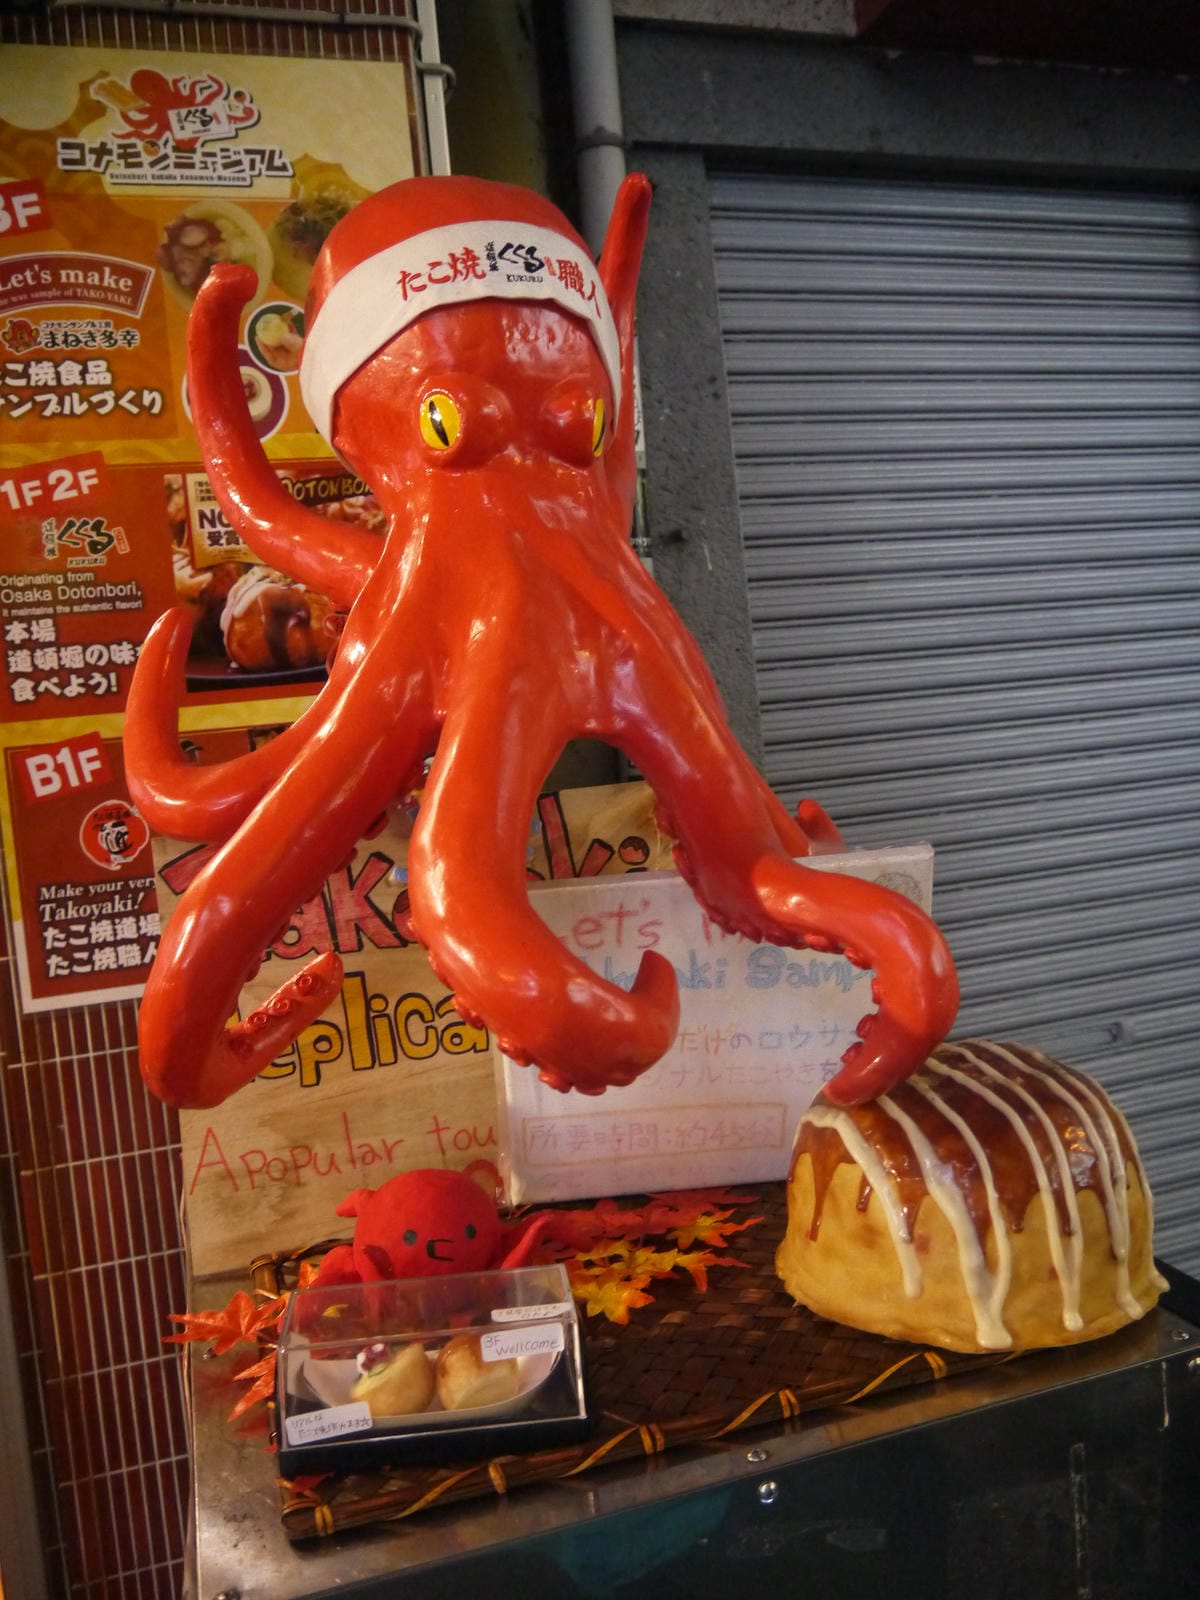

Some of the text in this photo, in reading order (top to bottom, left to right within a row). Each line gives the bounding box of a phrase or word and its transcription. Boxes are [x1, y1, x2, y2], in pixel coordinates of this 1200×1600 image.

[60, 267, 133, 292] make
[397, 246, 487, 300] たこ焼
[43, 330, 138, 348] まねき多幸
[0, 360, 112, 387] こ焼食品
[0, 390, 162, 418] ンプルづくり
[47, 468, 99, 502] 2F
[0, 571, 95, 587] Originating from
[1, 581, 143, 603] Osaka Dotonbori,
[5, 618, 56, 644] 本場
[8, 641, 144, 673] 道頓堀の味
[25, 746, 102, 798] B1F
[40, 884, 84, 900] Make
[89, 880, 124, 895] your
[40, 892, 145, 922] Takoyaki!
[190, 1127, 240, 1195] A
[239, 1111, 405, 1190] popular
